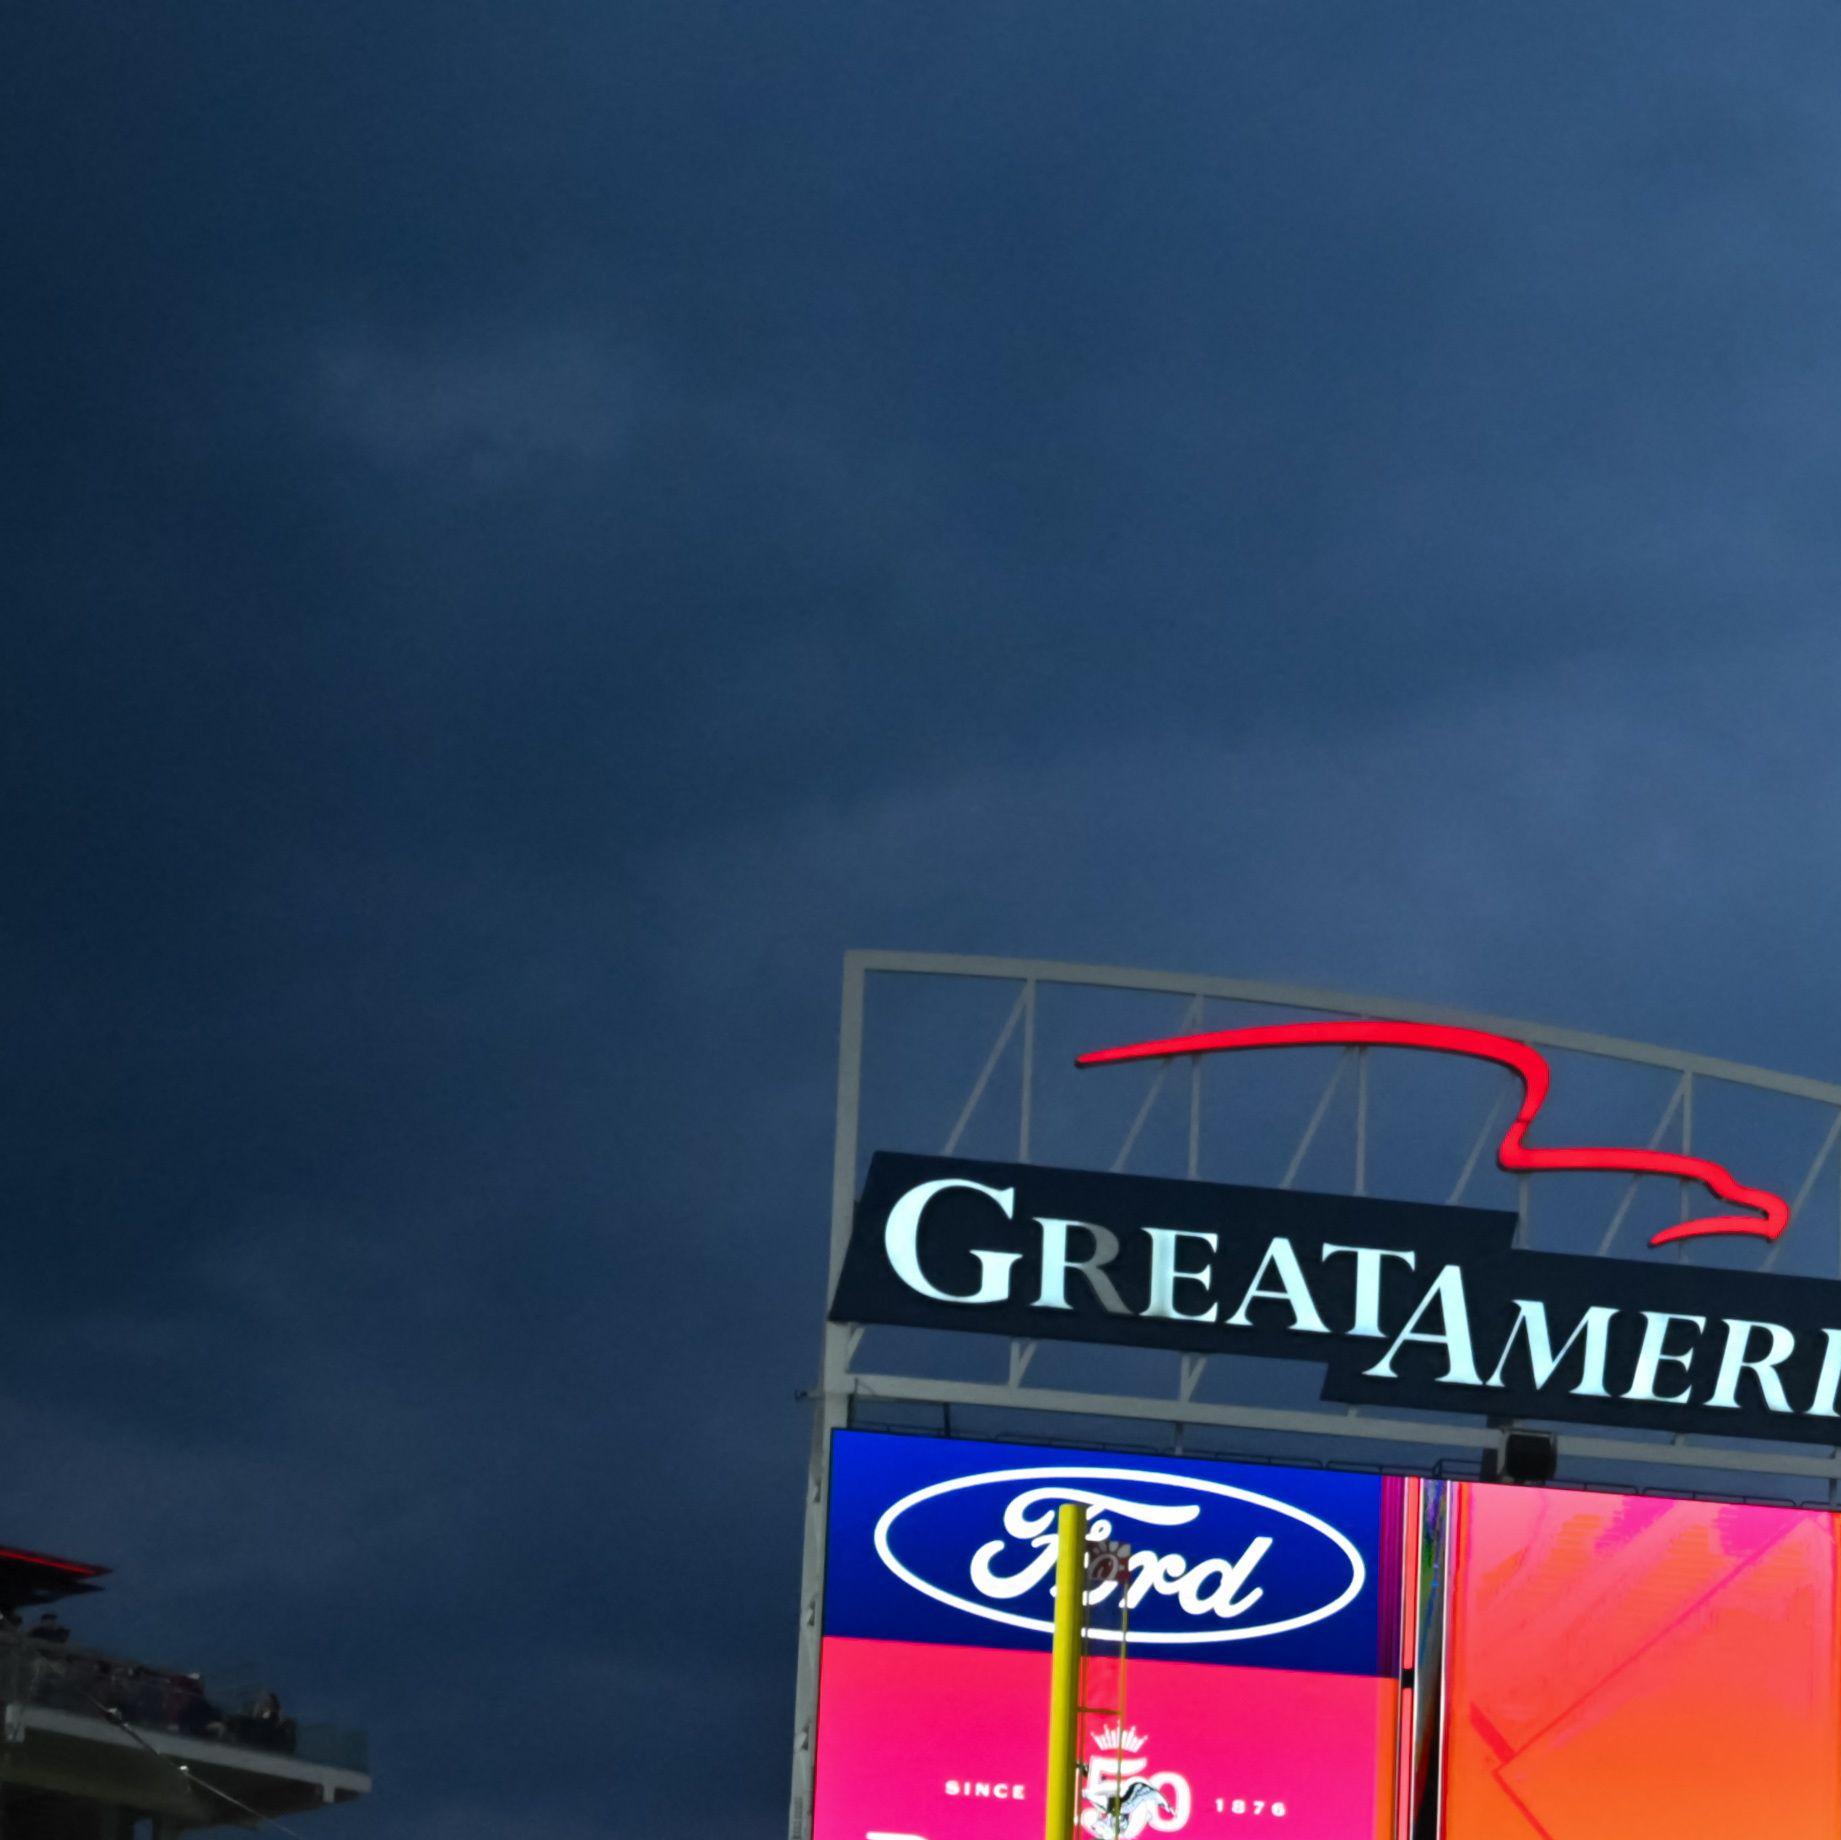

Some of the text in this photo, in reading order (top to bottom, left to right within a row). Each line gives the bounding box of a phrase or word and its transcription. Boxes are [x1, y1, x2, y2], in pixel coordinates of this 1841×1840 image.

[884, 1178, 1415, 1338] GREAT
[945, 1779, 1025, 1800] SINCE
[1215, 1798, 1286, 1817] 1876
